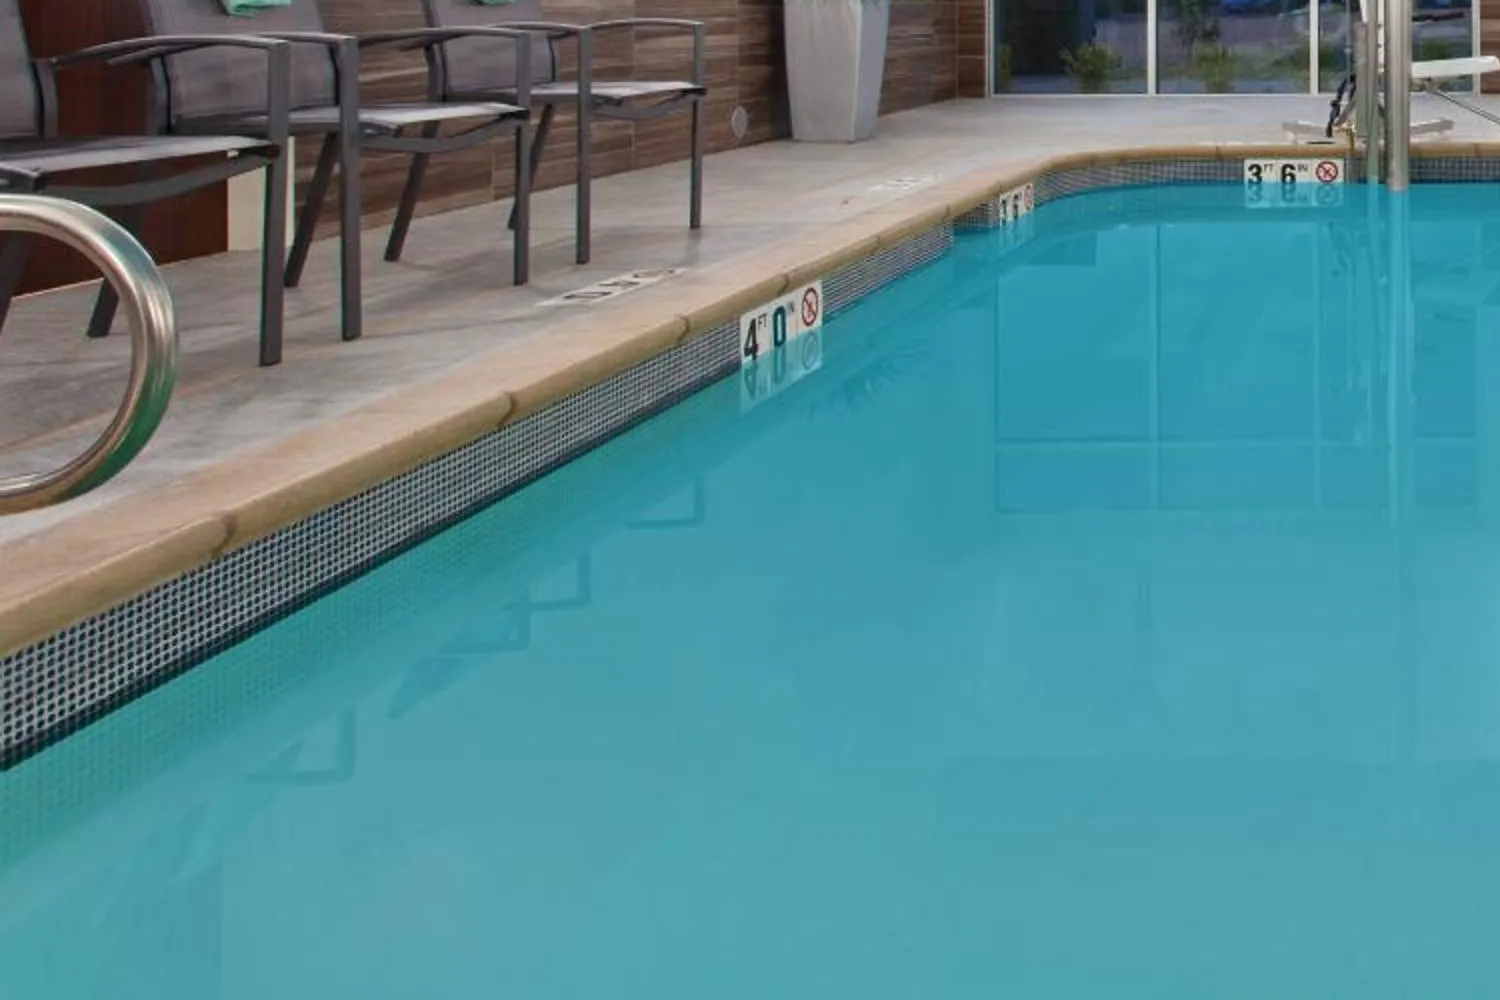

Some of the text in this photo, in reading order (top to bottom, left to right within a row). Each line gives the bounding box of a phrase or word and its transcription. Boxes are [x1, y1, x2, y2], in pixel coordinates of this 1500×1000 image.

[1248, 163, 1262, 184] 3
[1281, 163, 1296, 184] 6
[744, 318, 758, 361] 4
[773, 305, 786, 347] 0
